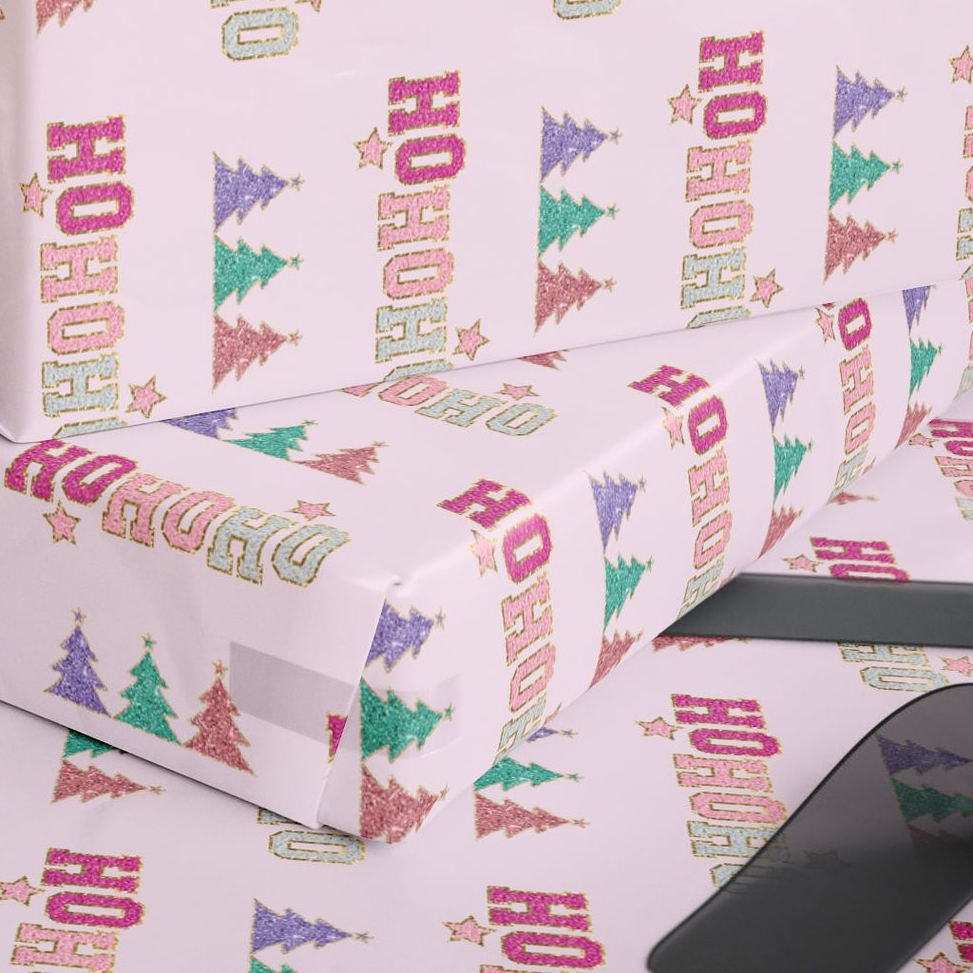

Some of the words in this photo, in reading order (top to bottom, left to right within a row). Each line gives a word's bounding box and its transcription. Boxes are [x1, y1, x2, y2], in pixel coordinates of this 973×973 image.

[4, 438, 351, 587] HOHOHO
[671, 693, 790, 889] HOHOH
[479, 885, 606, 973] HO
